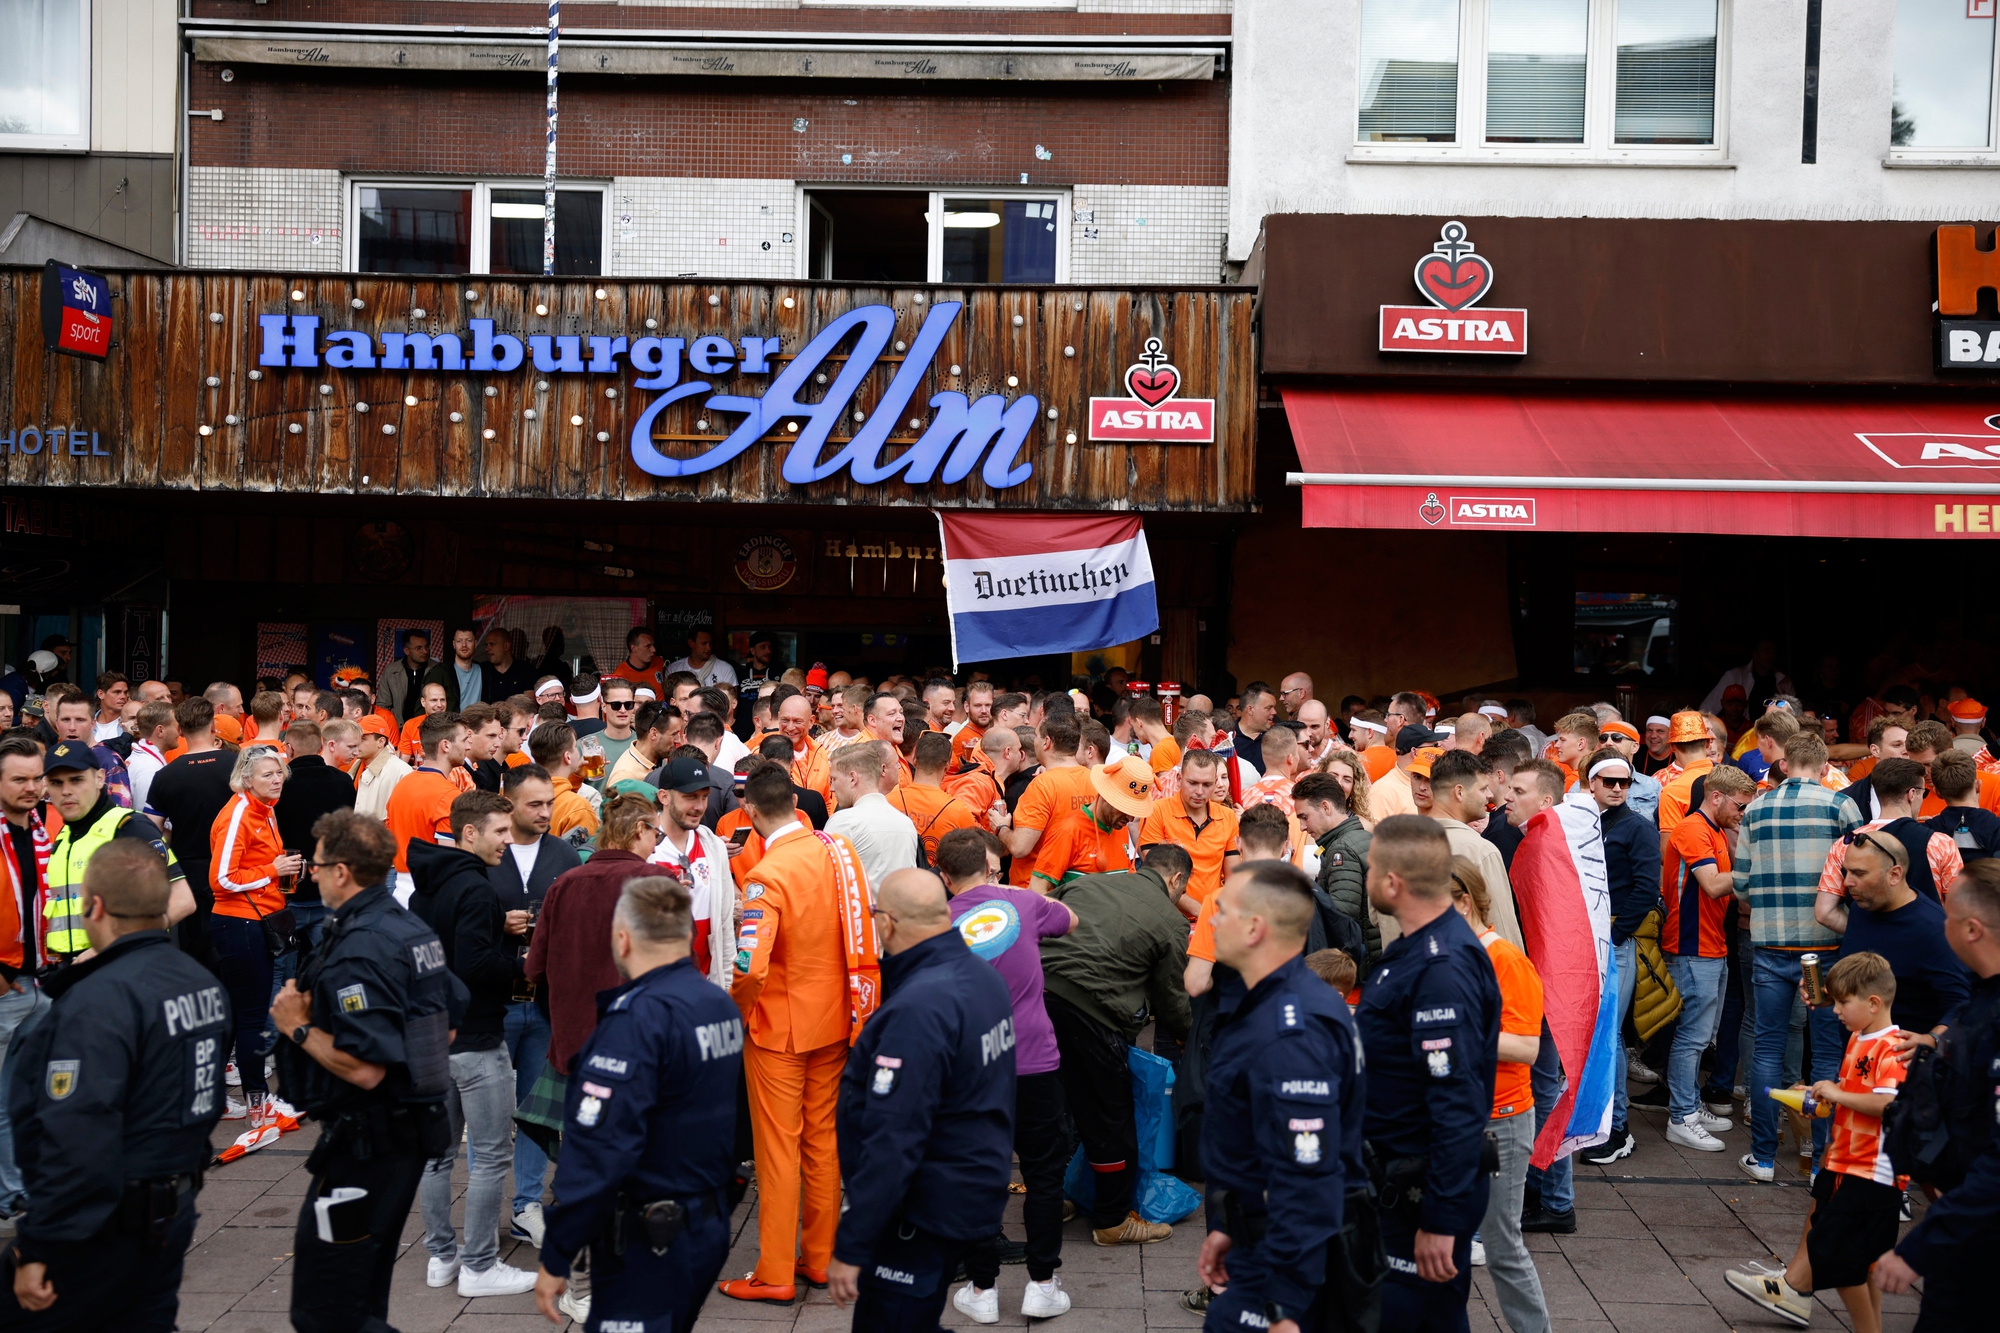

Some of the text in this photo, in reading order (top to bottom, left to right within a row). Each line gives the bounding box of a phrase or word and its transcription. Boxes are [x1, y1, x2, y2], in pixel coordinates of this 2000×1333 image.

[297, 47, 329, 63] Alm
[499, 53, 530, 66] Alm
[702, 57, 734, 71] Alm
[904, 59, 937, 74] Alm
[1104, 61, 1137, 76] Alm
[70, 322, 100, 344] sport
[1392, 317, 1515, 342] ASTRA
[258, 299, 1040, 490] Hamburger Alm
[1099, 410, 1204, 430] ASTRA
[0, 429, 110, 457] HOTEL
[1, 499, 73, 538] TABLE
[1457, 503, 1529, 518] ASTRA
[738, 535, 793, 558] ERDINGER
[972, 561, 1130, 600] Doetinchen
[1416, 1008, 1456, 1023] POLICJA
[195, 1038, 215, 1066] BP
[588, 1055, 627, 1075] POLICJA
[195, 1063, 215, 1091] RZ
[1282, 1080, 1330, 1096] POLICJA
[875, 1265, 915, 1285] POLICJA
